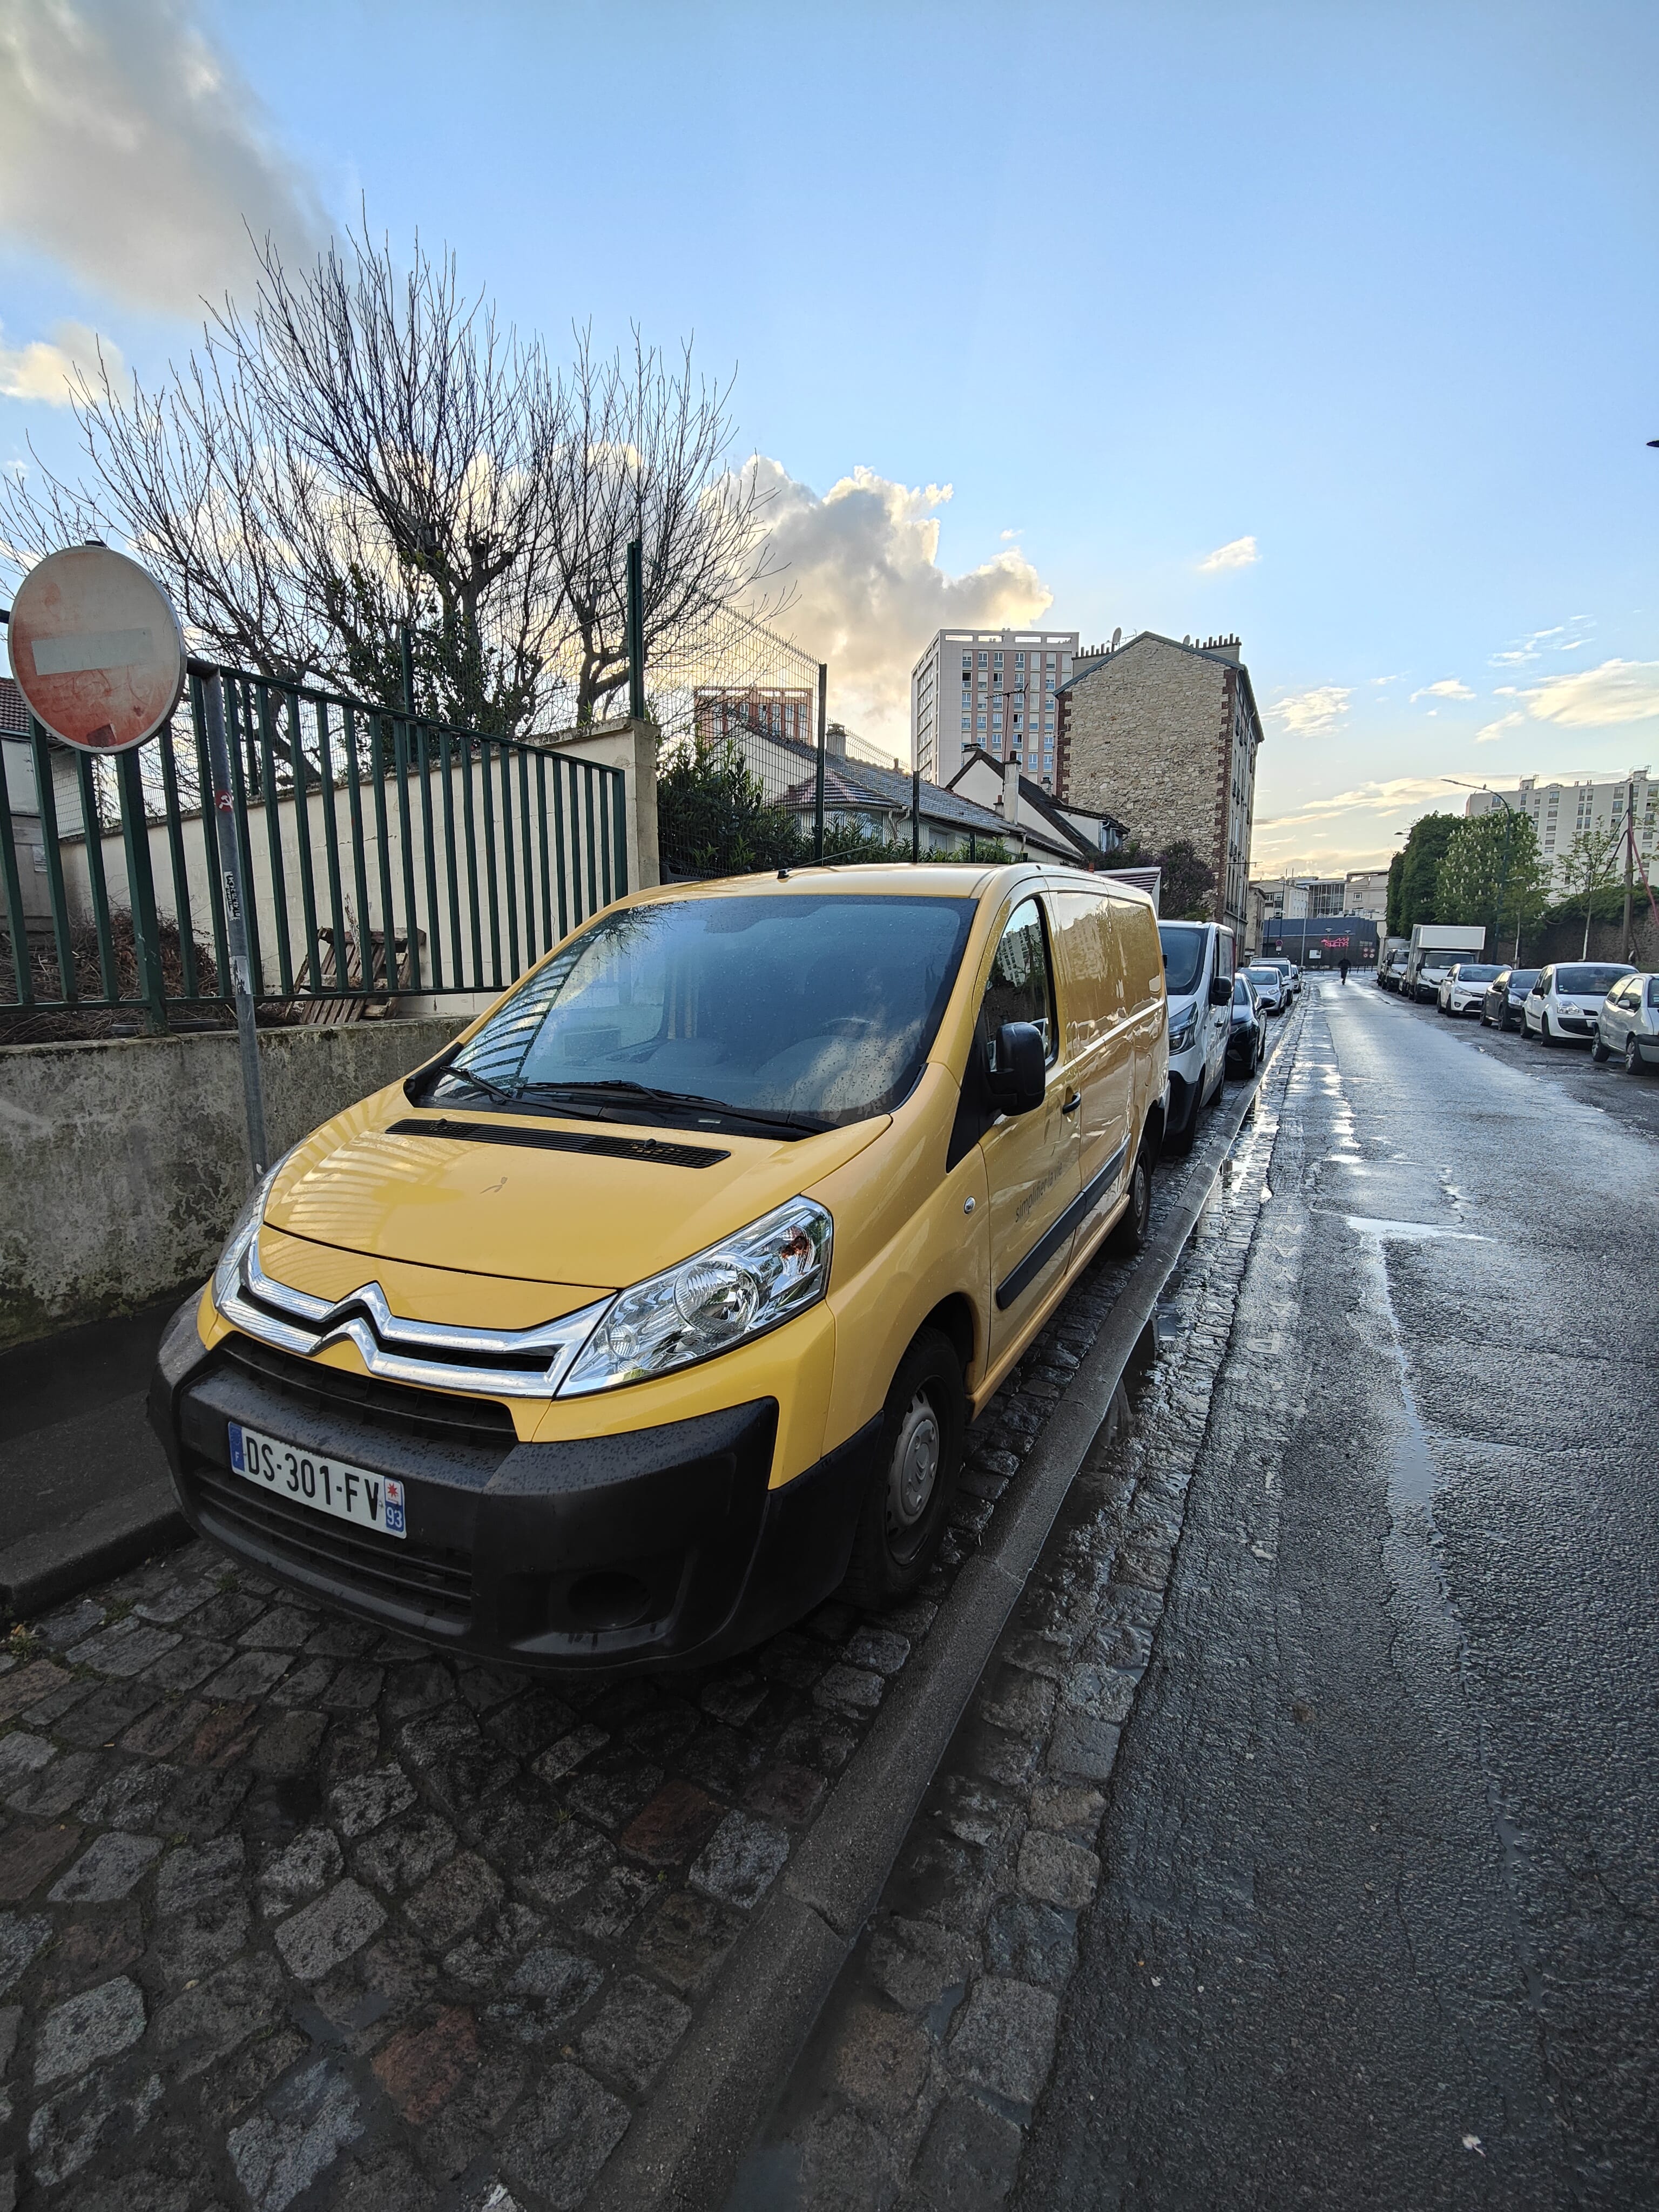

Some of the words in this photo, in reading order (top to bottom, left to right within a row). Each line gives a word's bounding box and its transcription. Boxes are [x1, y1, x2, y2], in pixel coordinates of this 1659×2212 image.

[1015, 1178, 1047, 1223] simplifier
[1048, 1169, 1053, 1188] la
[234, 1452, 240, 1462] F
[246, 1436, 379, 1521] DS-301-FV
[387, 1506, 402, 1528] 93
